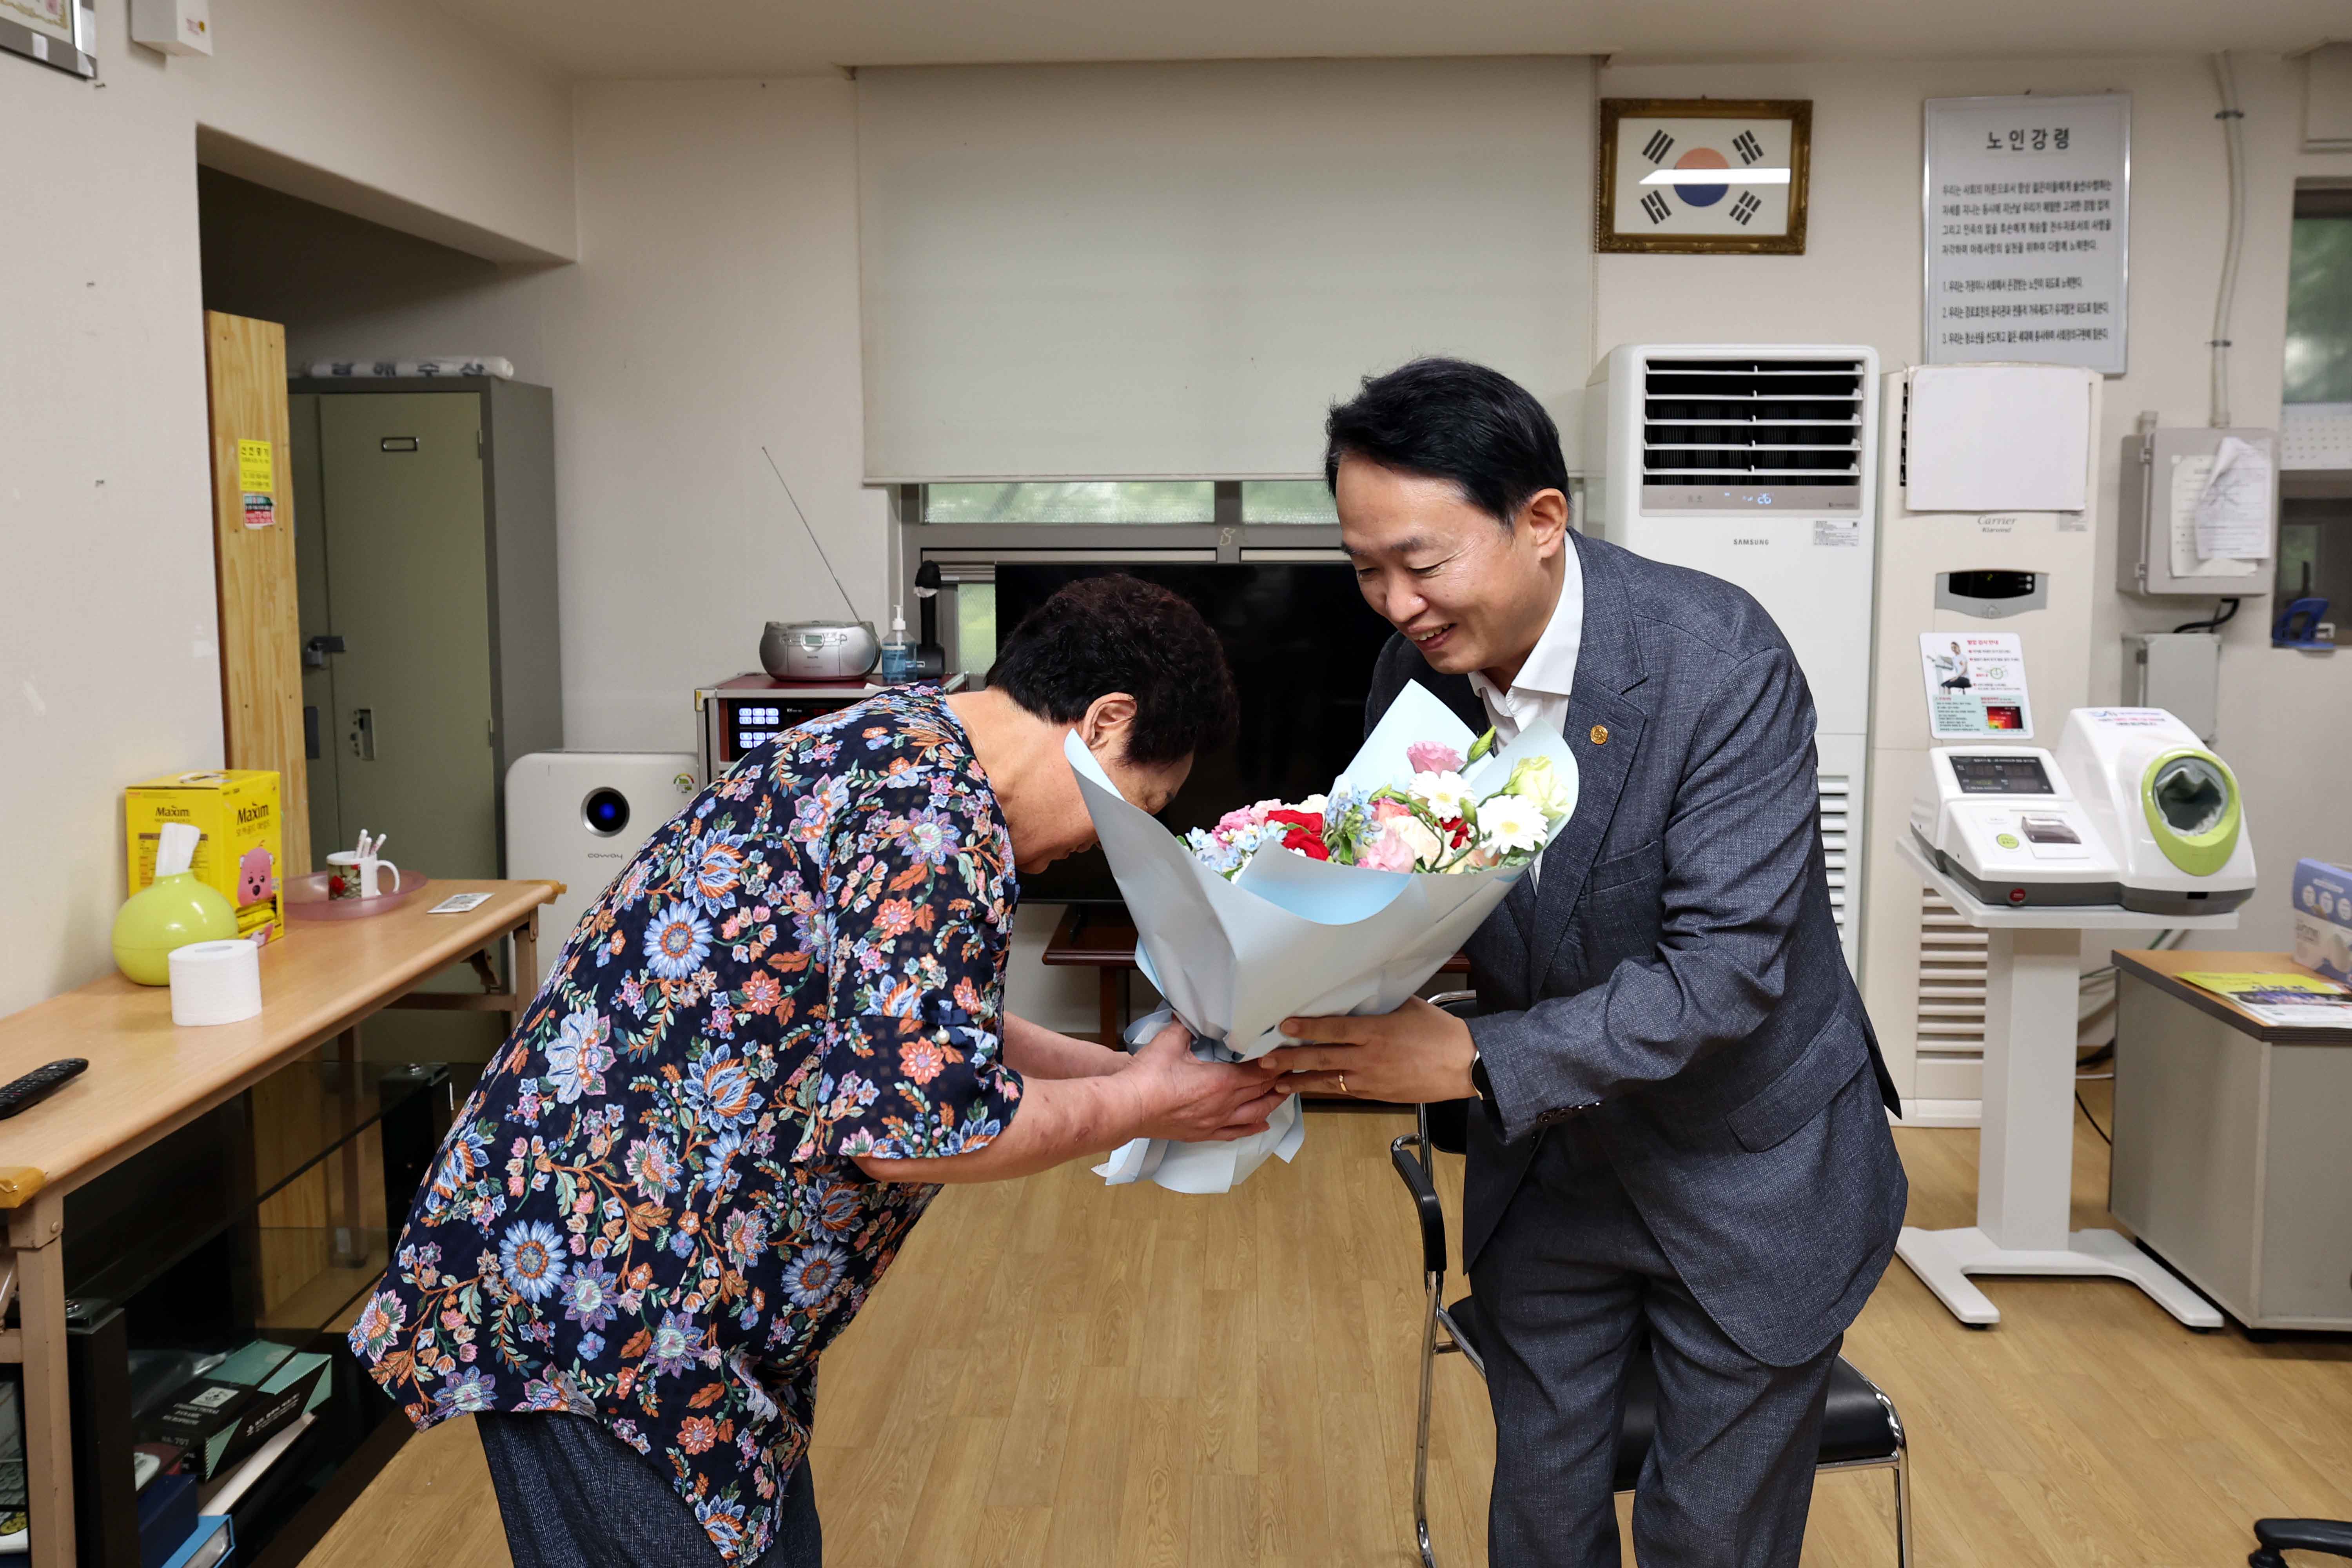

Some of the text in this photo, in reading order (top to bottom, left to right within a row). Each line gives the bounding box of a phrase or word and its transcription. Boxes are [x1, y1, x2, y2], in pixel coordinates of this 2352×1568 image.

[1986, 127, 2070, 151] 노인강령
[1943, 184, 1962, 196] 우리는
[1977, 515, 2017, 524] Carrier
[155, 805, 190, 817] Maxim
[237, 802, 269, 825] Maxim
